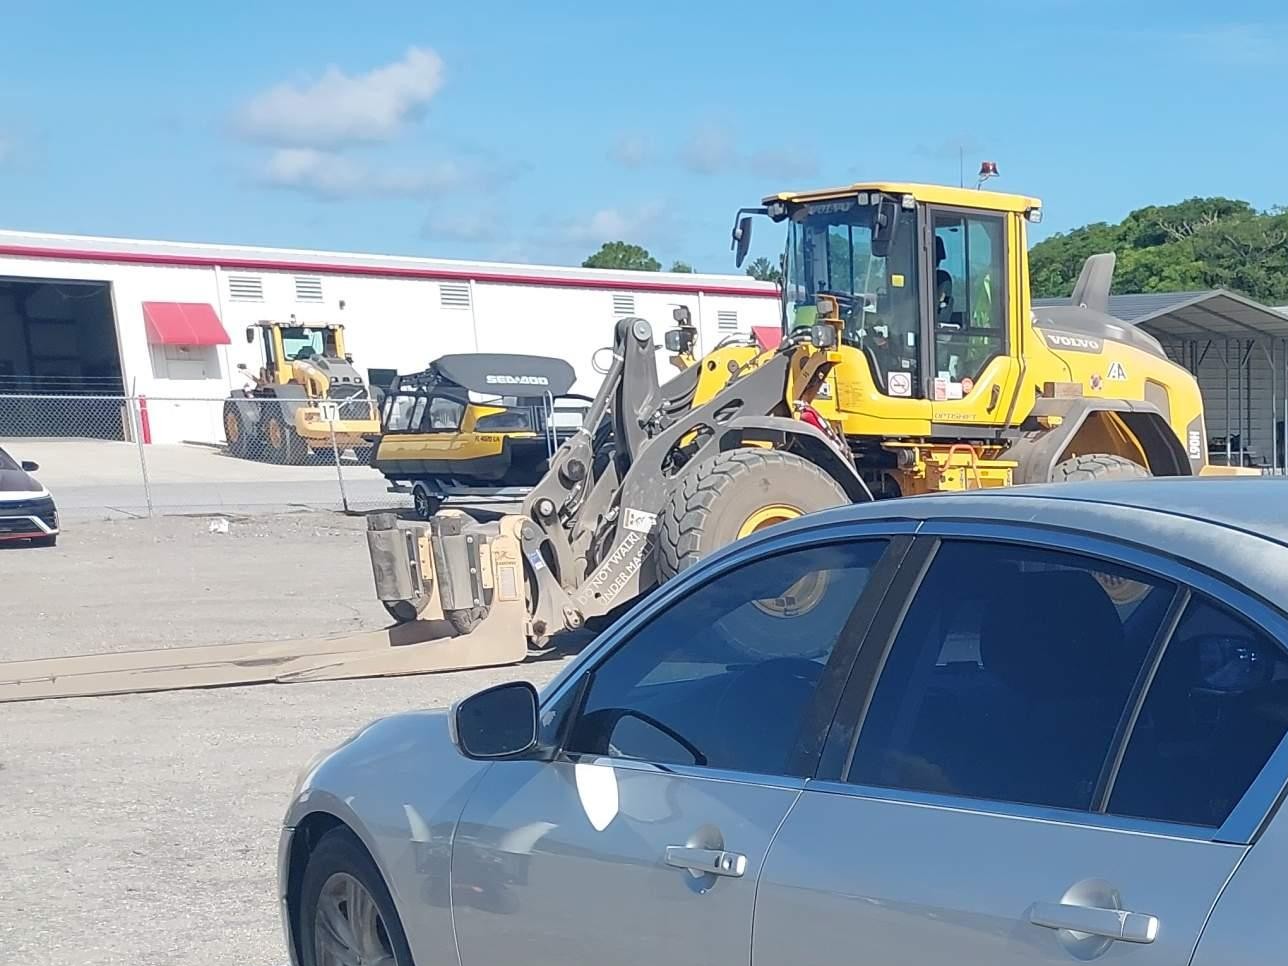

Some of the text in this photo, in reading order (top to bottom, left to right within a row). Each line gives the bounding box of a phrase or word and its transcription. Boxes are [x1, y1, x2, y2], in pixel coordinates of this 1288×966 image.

[1047, 334, 1099, 349] VOLVO
[322, 405, 336, 420] 17
[1189, 431, 1200, 459] L90H
[579, 587, 593, 605] DO
[592, 563, 612, 588] NOT
